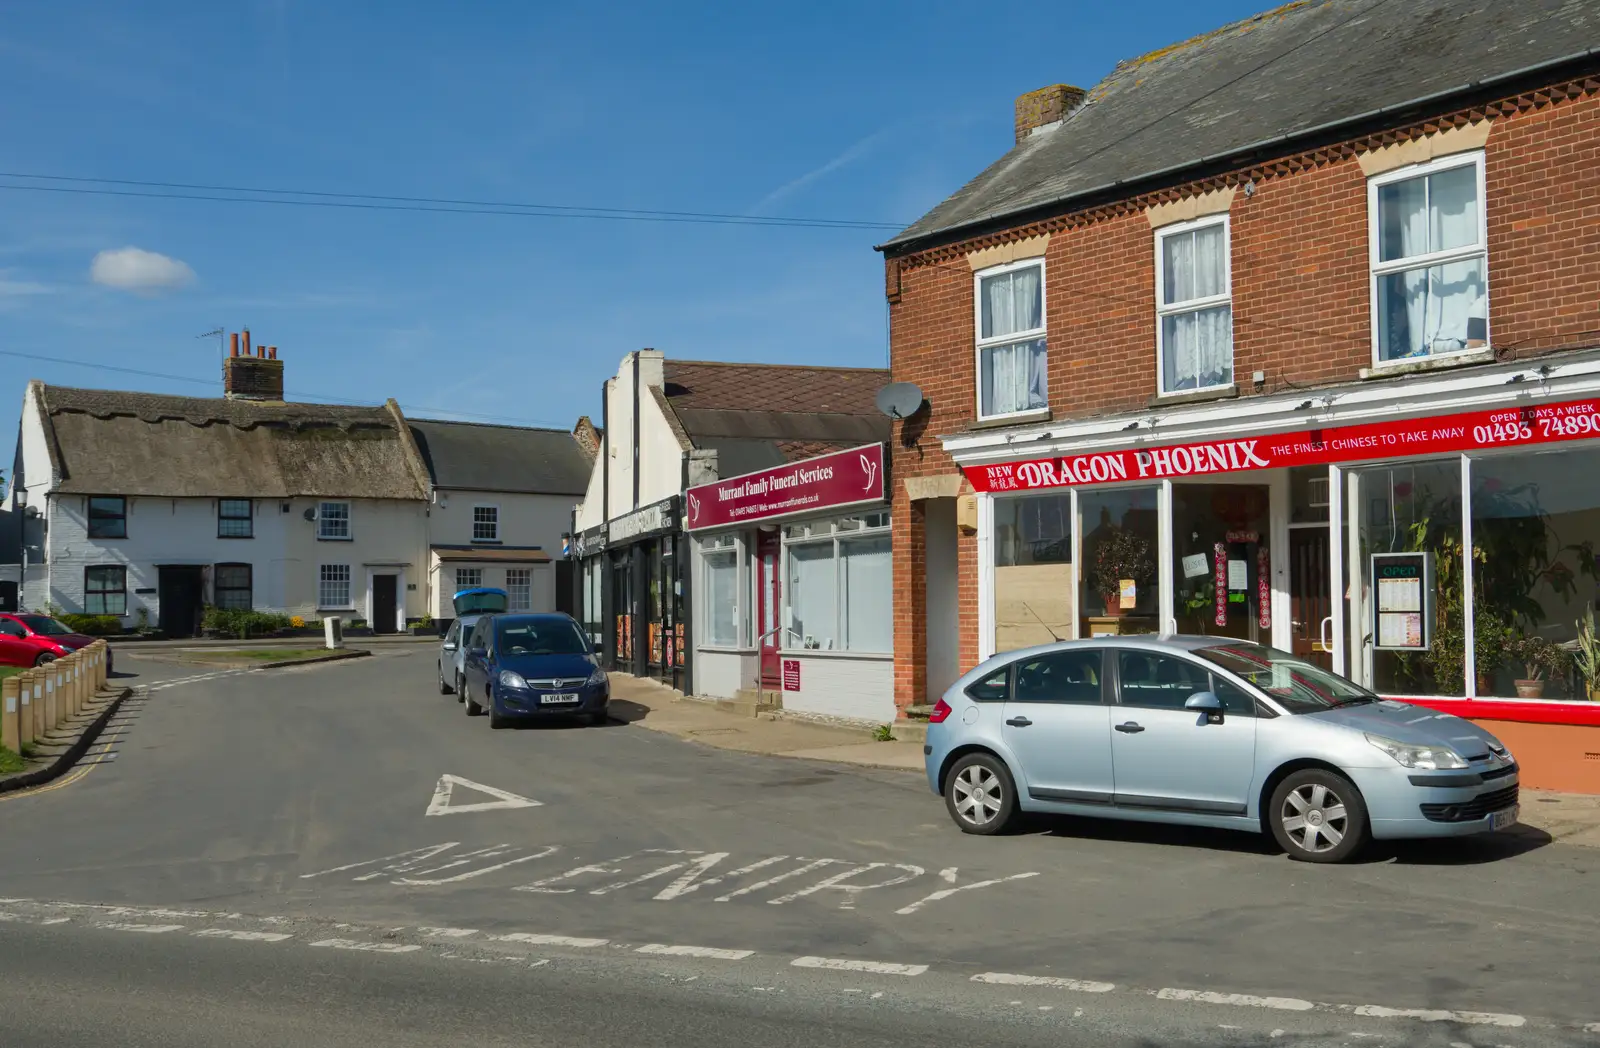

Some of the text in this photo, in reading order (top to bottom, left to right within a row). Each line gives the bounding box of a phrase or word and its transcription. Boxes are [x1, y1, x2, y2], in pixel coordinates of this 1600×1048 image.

[1490, 412, 1517, 423] OPEN
[1528, 408, 1554, 419] DAYS
[1556, 407, 1564, 416] A
[1565, 403, 1595, 415] WEEK
[1271, 426, 1466, 457] THE FINEST CHINESE TO TAKE AWAY
[1473, 420, 1532, 444] 01493
[986, 465, 1013, 478] NEW
[1017, 439, 1270, 488] DRAGON PHOENIX
[718, 465, 833, 502] Murrant Family Funeral Services
[511, 848, 1040, 915] ENTRY
